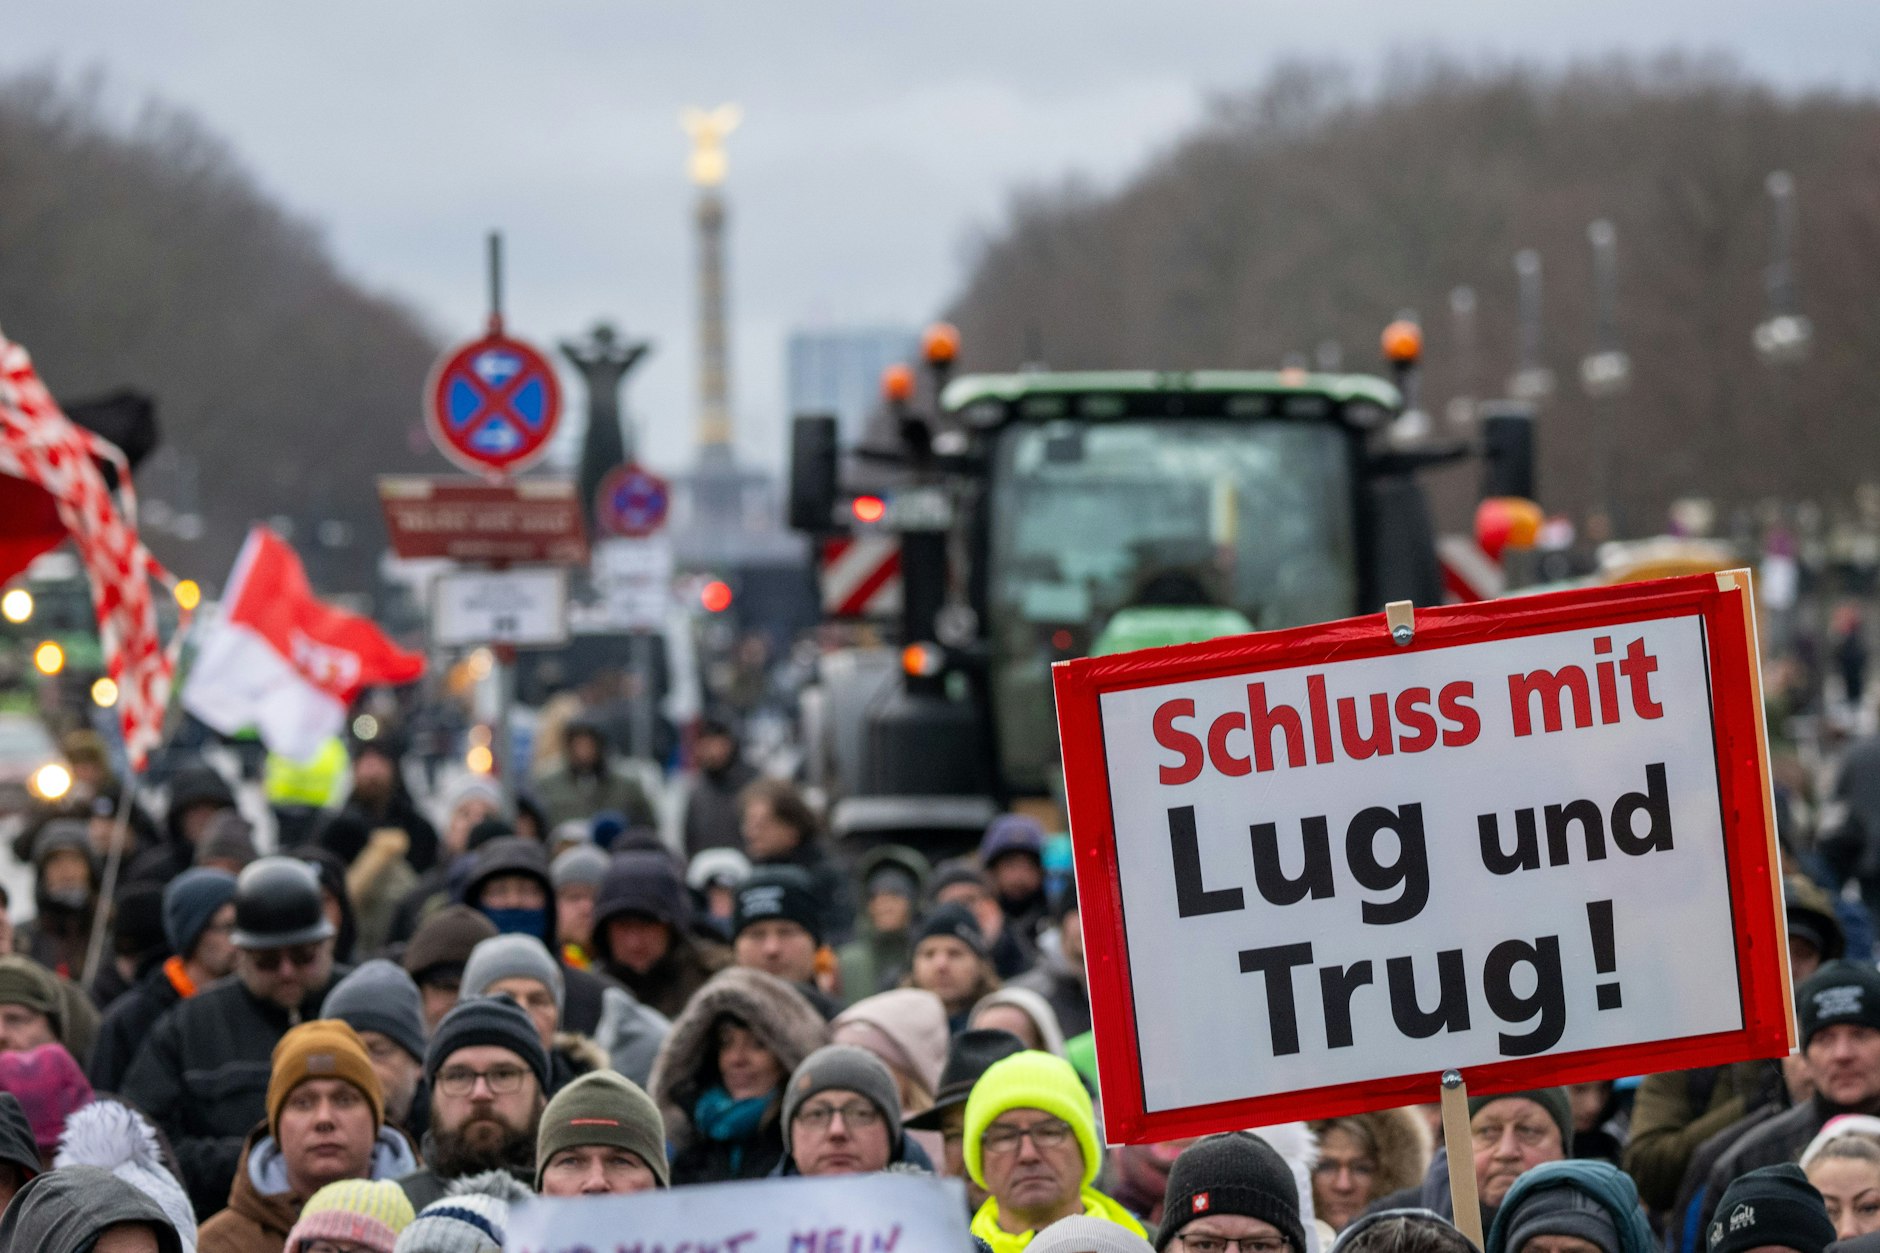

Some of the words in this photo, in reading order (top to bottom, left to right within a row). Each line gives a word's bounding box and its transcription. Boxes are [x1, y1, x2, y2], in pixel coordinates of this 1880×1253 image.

[1152, 673, 1482, 786] Schluss
[1507, 635, 1664, 738] mit
[1167, 801, 1431, 926] Lug
[1476, 761, 1676, 876] und
[1238, 898, 1624, 1057] Trug!
